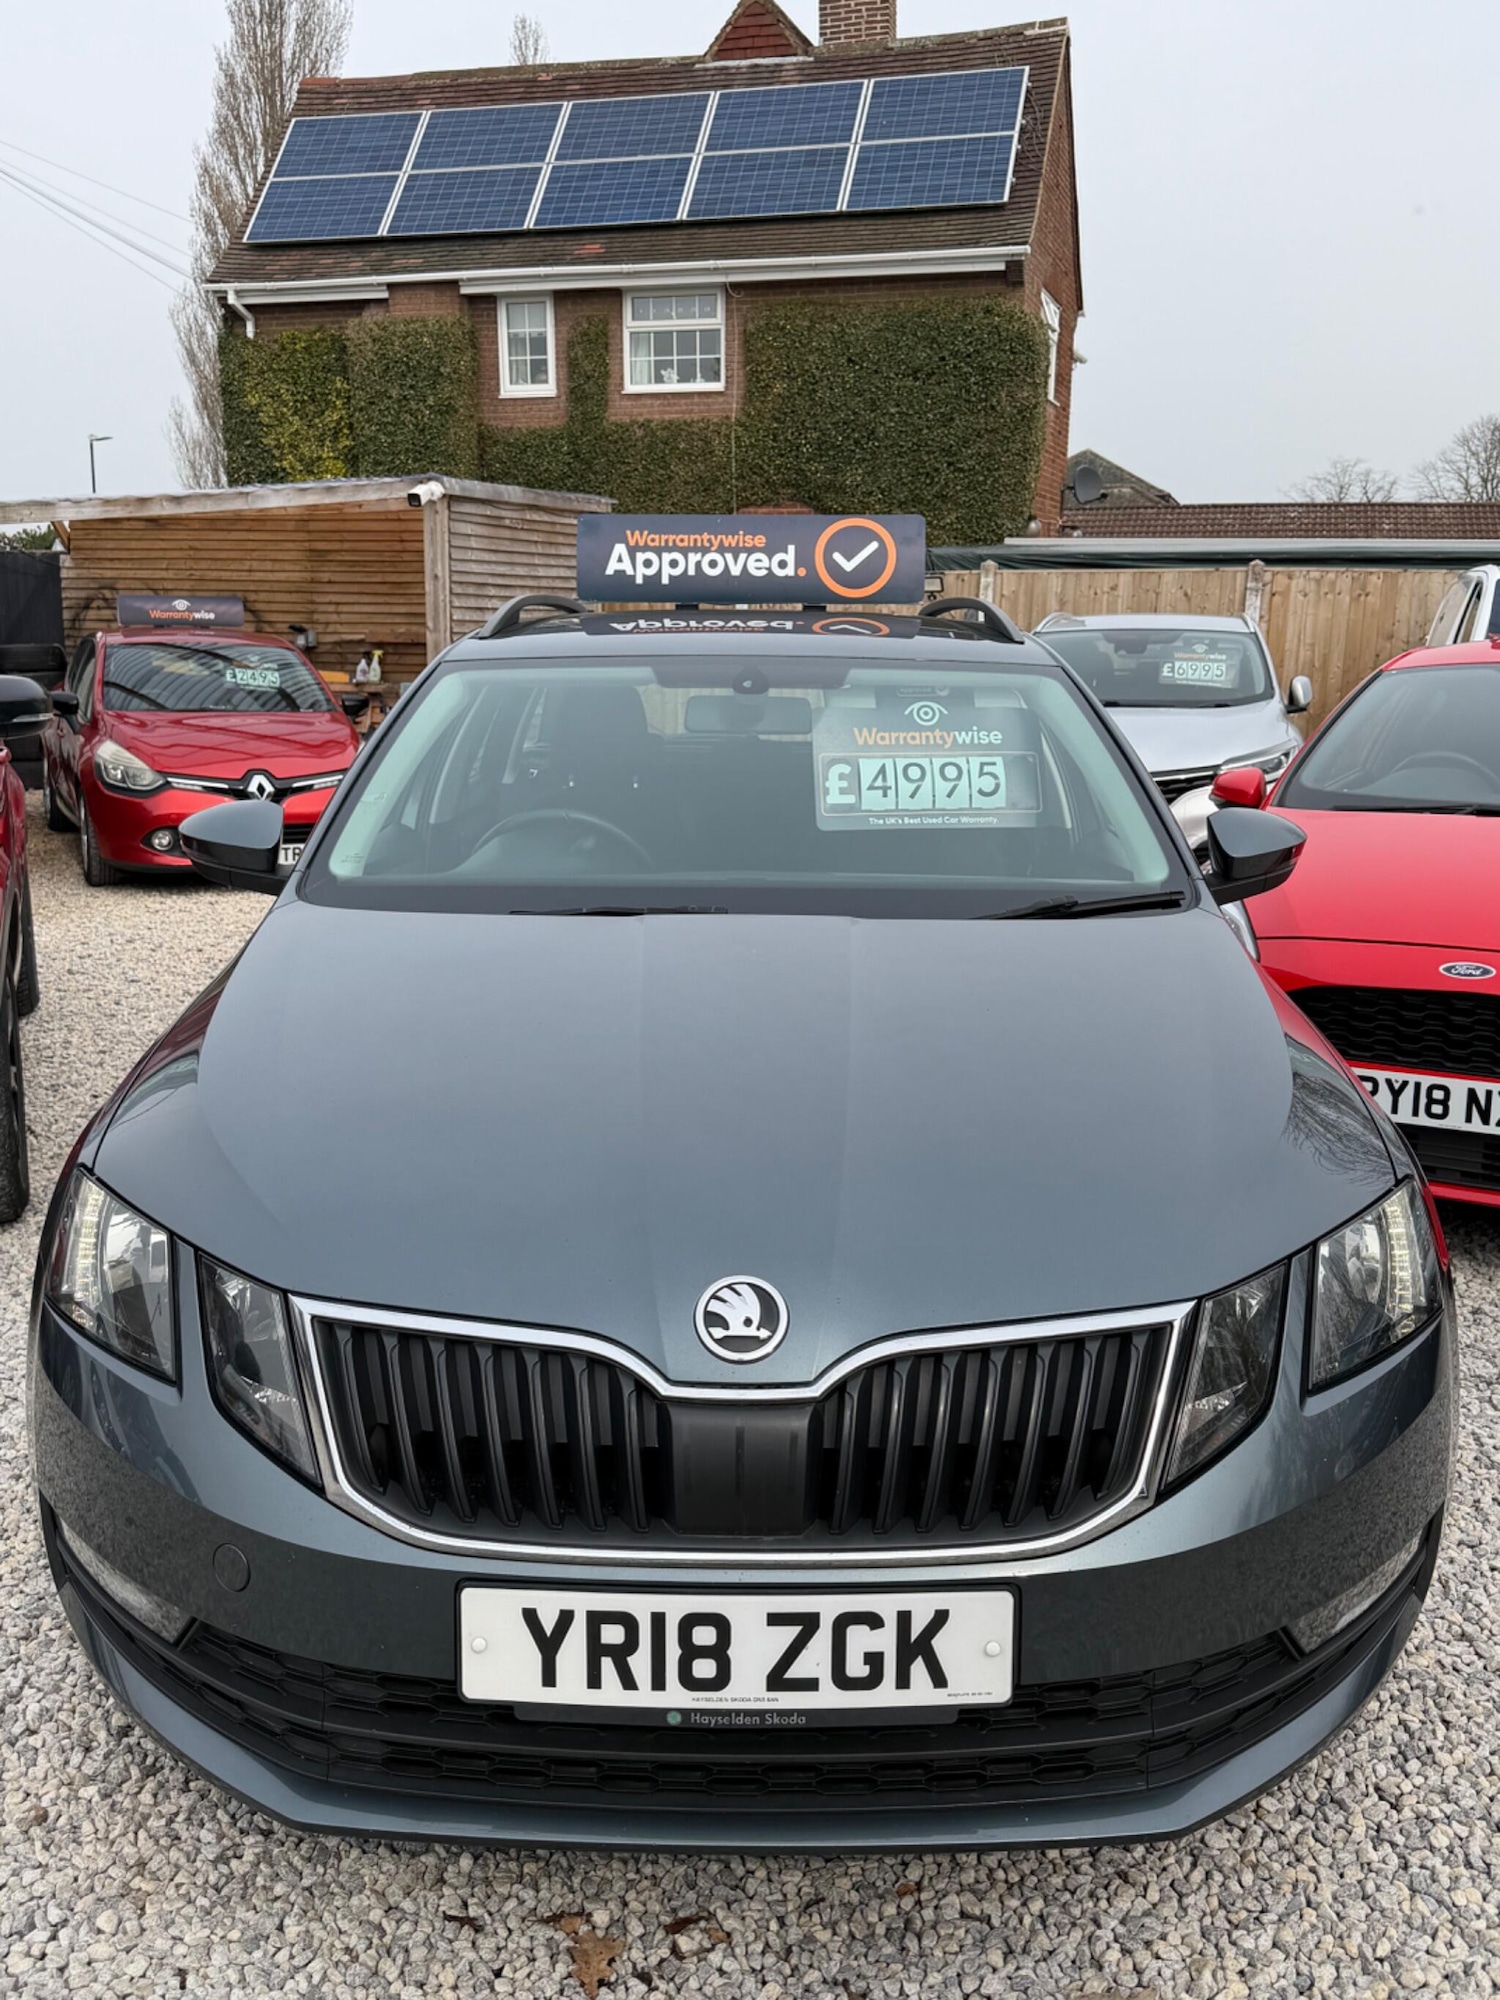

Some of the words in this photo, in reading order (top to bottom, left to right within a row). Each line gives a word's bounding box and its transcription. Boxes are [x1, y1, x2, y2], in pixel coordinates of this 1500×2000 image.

[625, 530, 766, 551] Warrantywise
[604, 543, 807, 585] Approved.
[149, 609, 216, 622] Warrantywise
[226, 669, 278, 685] £2495
[1162, 662, 1224, 678] £6995
[853, 726, 1003, 748] Warrantywise
[825, 761, 1001, 804] £4995
[868, 817, 884, 825] The
[885, 817, 902, 825] UK's
[904, 816, 921, 825] Best
[922, 816, 941, 824] Used
[944, 816, 959, 824] Car
[1450, 964, 1483, 977] Ford
[1464, 1087, 1500, 1128] N
[521, 1607, 732, 1692] YR18
[765, 1608, 951, 1692] ZGK
[691, 1712, 760, 1727] Hayselden
[764, 1712, 806, 1725] Skoda
